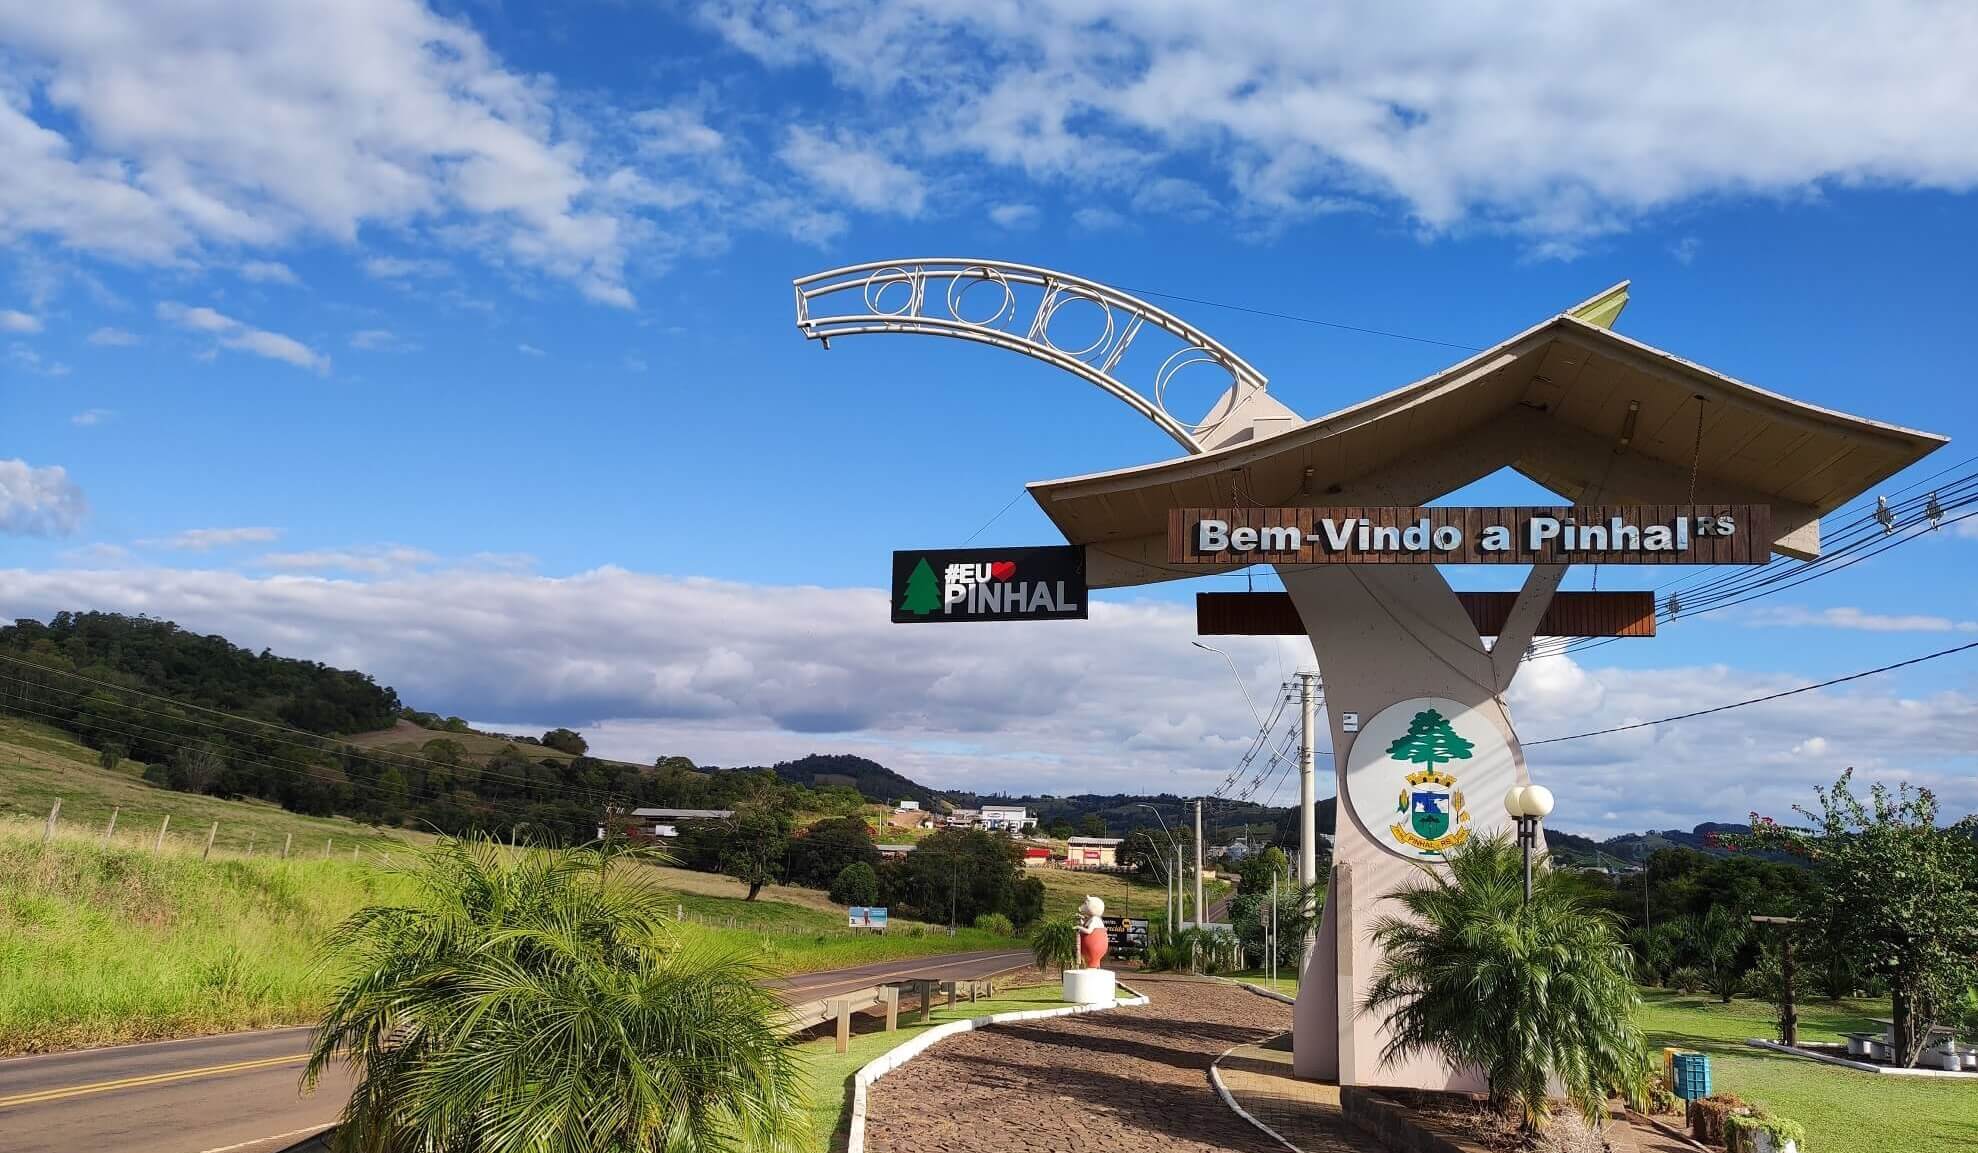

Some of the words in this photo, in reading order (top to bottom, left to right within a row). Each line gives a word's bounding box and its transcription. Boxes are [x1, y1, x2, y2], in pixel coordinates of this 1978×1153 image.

[1199, 518, 1463, 551] Bem-Vindo
[1481, 525, 1511, 551] a
[1529, 516, 1689, 551] Pinhal
[1696, 516, 1736, 536] RS
[944, 562, 993, 585] #EU
[944, 580, 1078, 615] PINHAL
[1407, 836, 1435, 849] PINHAL
[1440, 838, 1452, 847] RS
